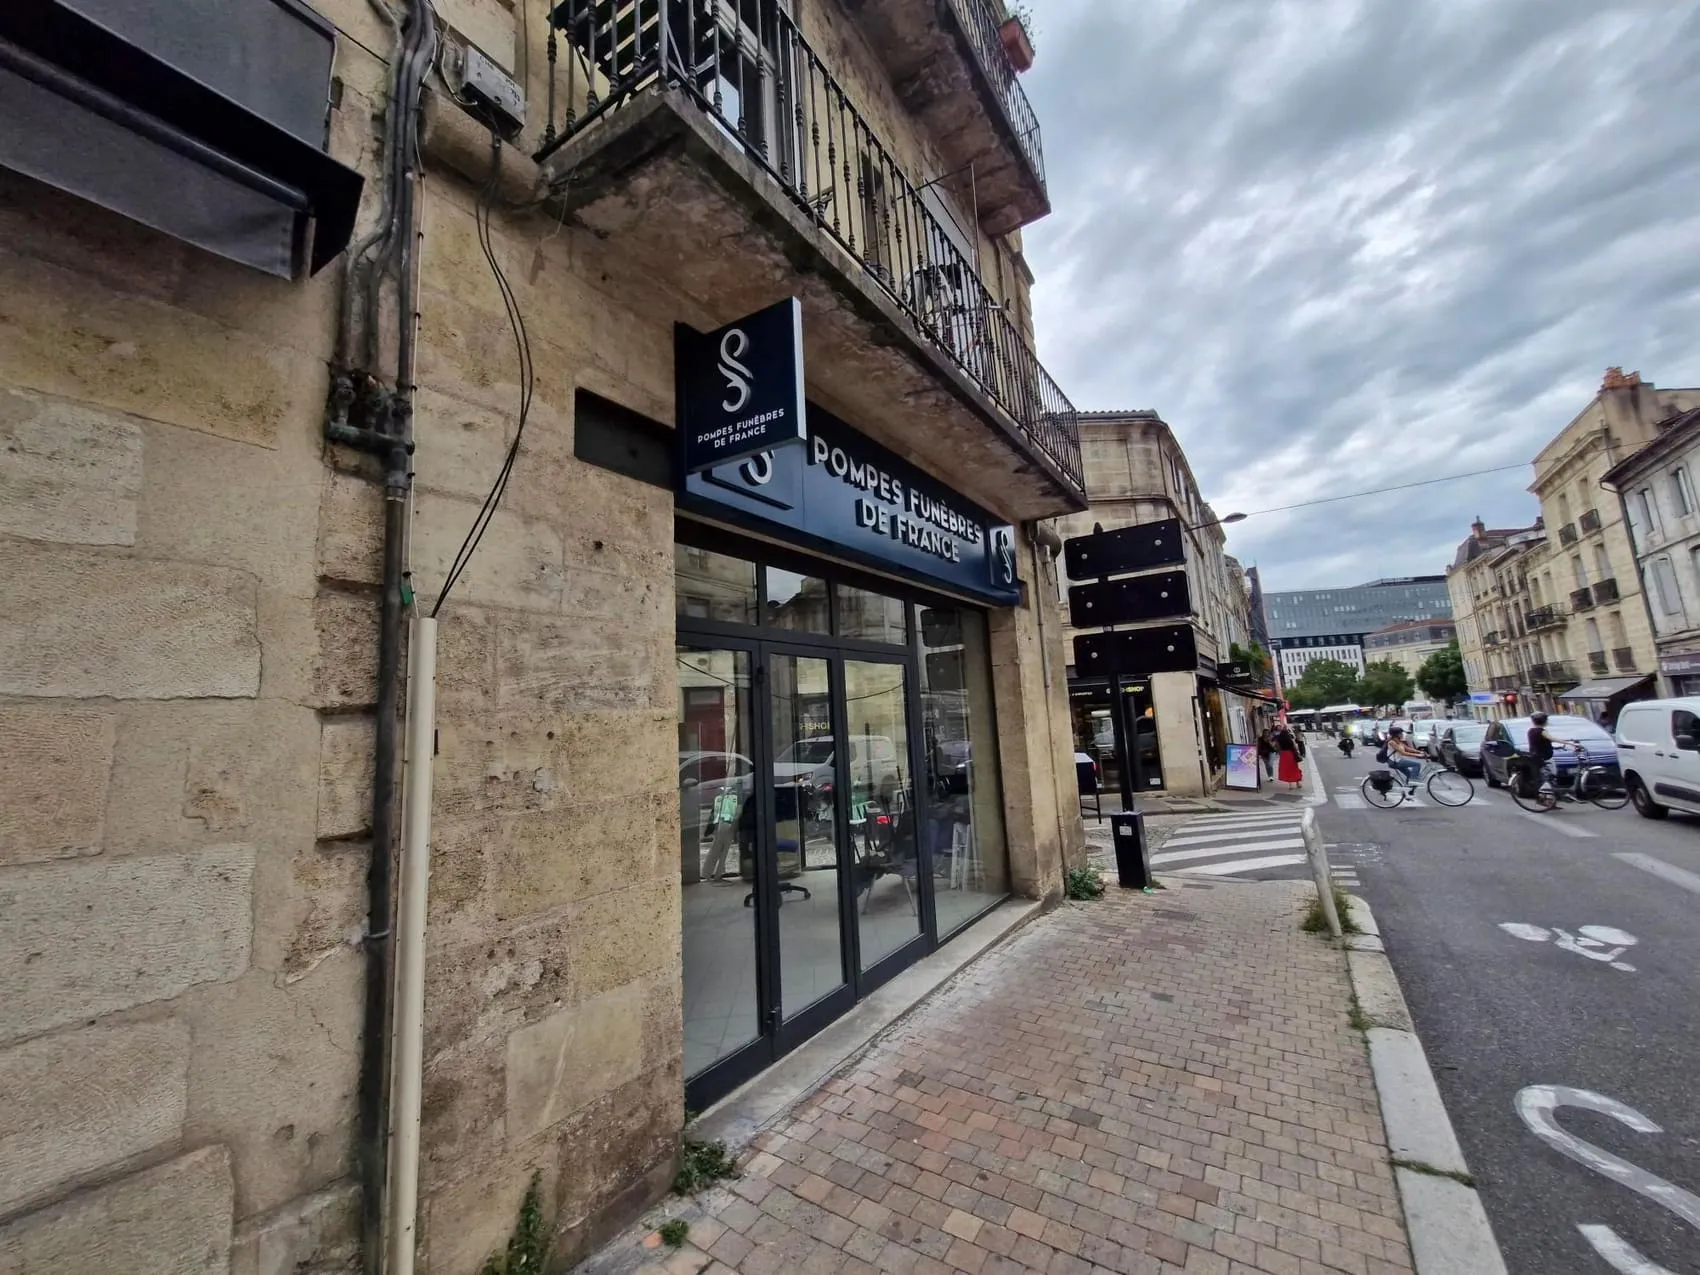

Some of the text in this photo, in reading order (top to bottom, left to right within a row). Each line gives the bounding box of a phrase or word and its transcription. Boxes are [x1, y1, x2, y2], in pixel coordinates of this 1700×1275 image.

[697, 408, 785, 444] POMPES FUNÈBRES
[714, 424, 766, 448] DE FRANCE
[813, 435, 982, 543] POMPES FUNÈBRES
[862, 498, 961, 563] DE FRANCE
